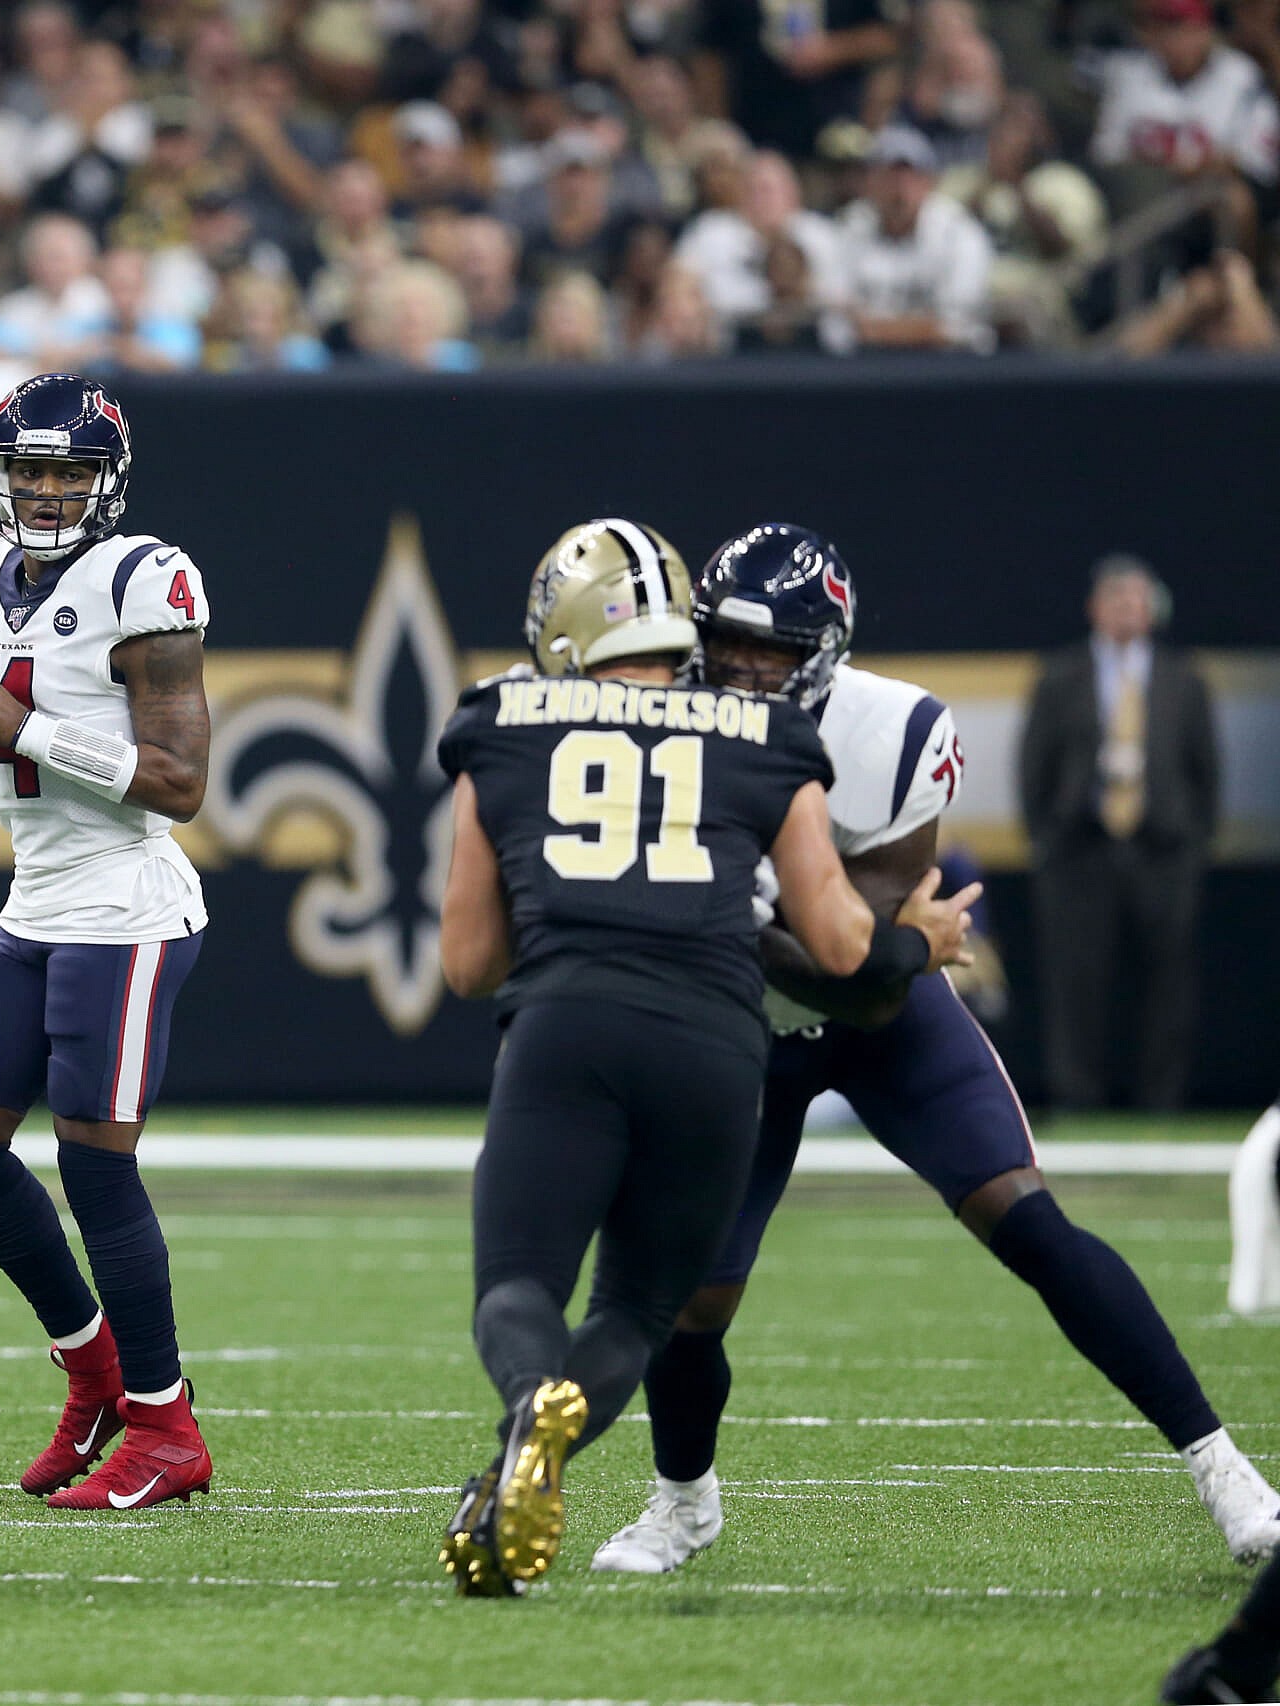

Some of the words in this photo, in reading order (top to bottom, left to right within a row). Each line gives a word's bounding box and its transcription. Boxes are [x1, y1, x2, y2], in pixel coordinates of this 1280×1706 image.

[167, 570, 195, 620] 4
[495, 678, 770, 746] HENDRICKSON
[543, 730, 714, 882] 91
